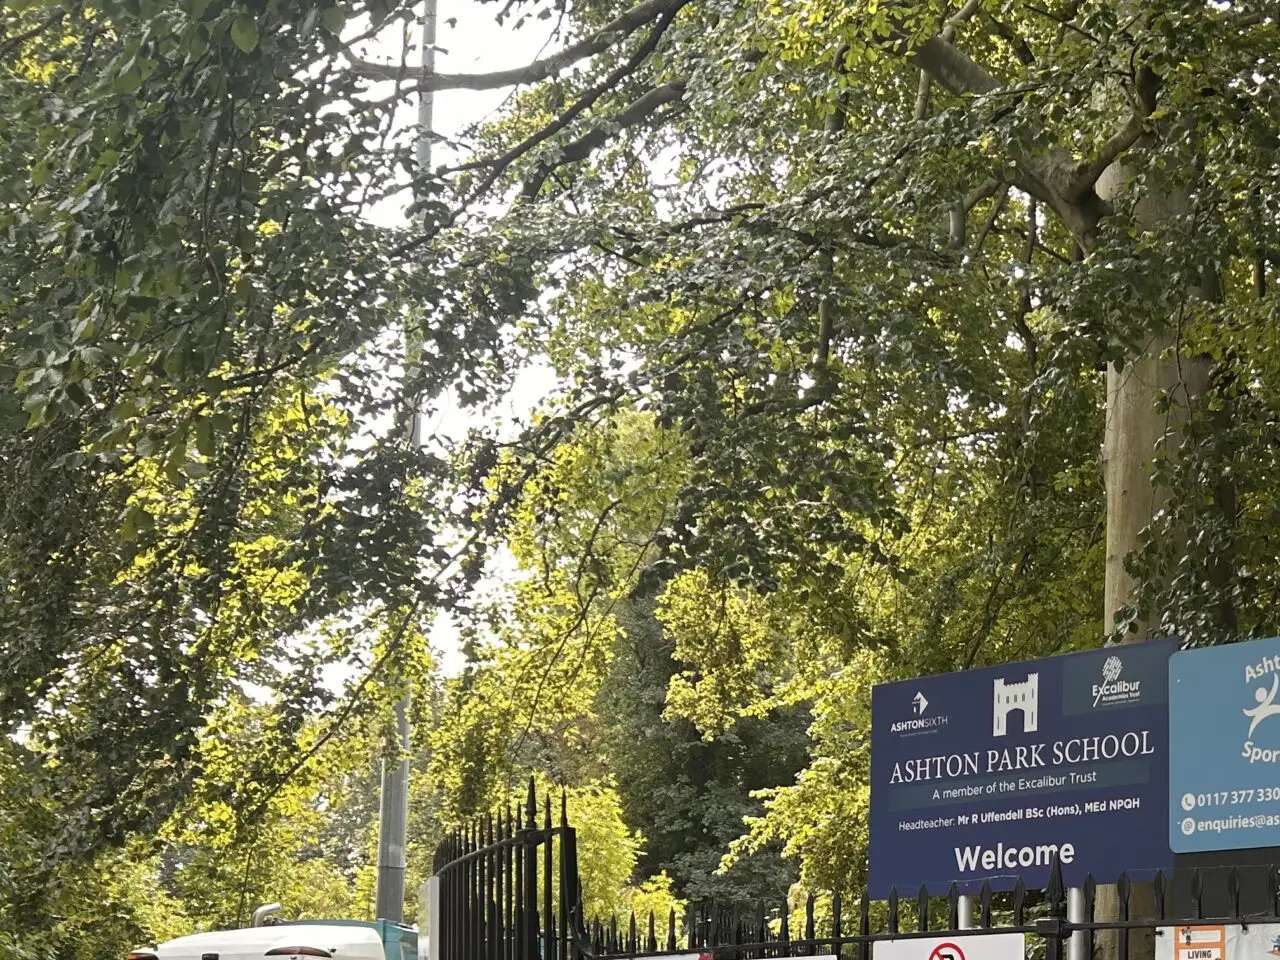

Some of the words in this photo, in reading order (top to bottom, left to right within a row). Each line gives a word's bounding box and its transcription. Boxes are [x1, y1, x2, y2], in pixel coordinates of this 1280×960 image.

[1092, 681, 1140, 698] Excalibur
[889, 752, 980, 784] ASHTON
[986, 744, 1046, 773] PARK
[1052, 731, 1155, 765] SCHOOL
[932, 789, 940, 800] A
[943, 785, 983, 799] member
[986, 781, 997, 794] of
[999, 781, 1016, 792] the
[1018, 775, 1067, 790] Excalibur
[1069, 771, 1097, 784] Trust
[1197, 792, 1228, 807] 0117
[1230, 790, 1254, 804] 377
[898, 817, 955, 831] Headteacher:
[957, 814, 970, 826] Mr
[971, 813, 979, 824] R
[980, 808, 1023, 823] Uffendell
[1025, 807, 1044, 819] BSc
[1046, 804, 1082, 818] (Hons),
[1084, 799, 1106, 813] MEd
[1109, 797, 1140, 810] NPQH
[954, 841, 1075, 872] Welcome
[1187, 950, 1212, 959] LIVING
